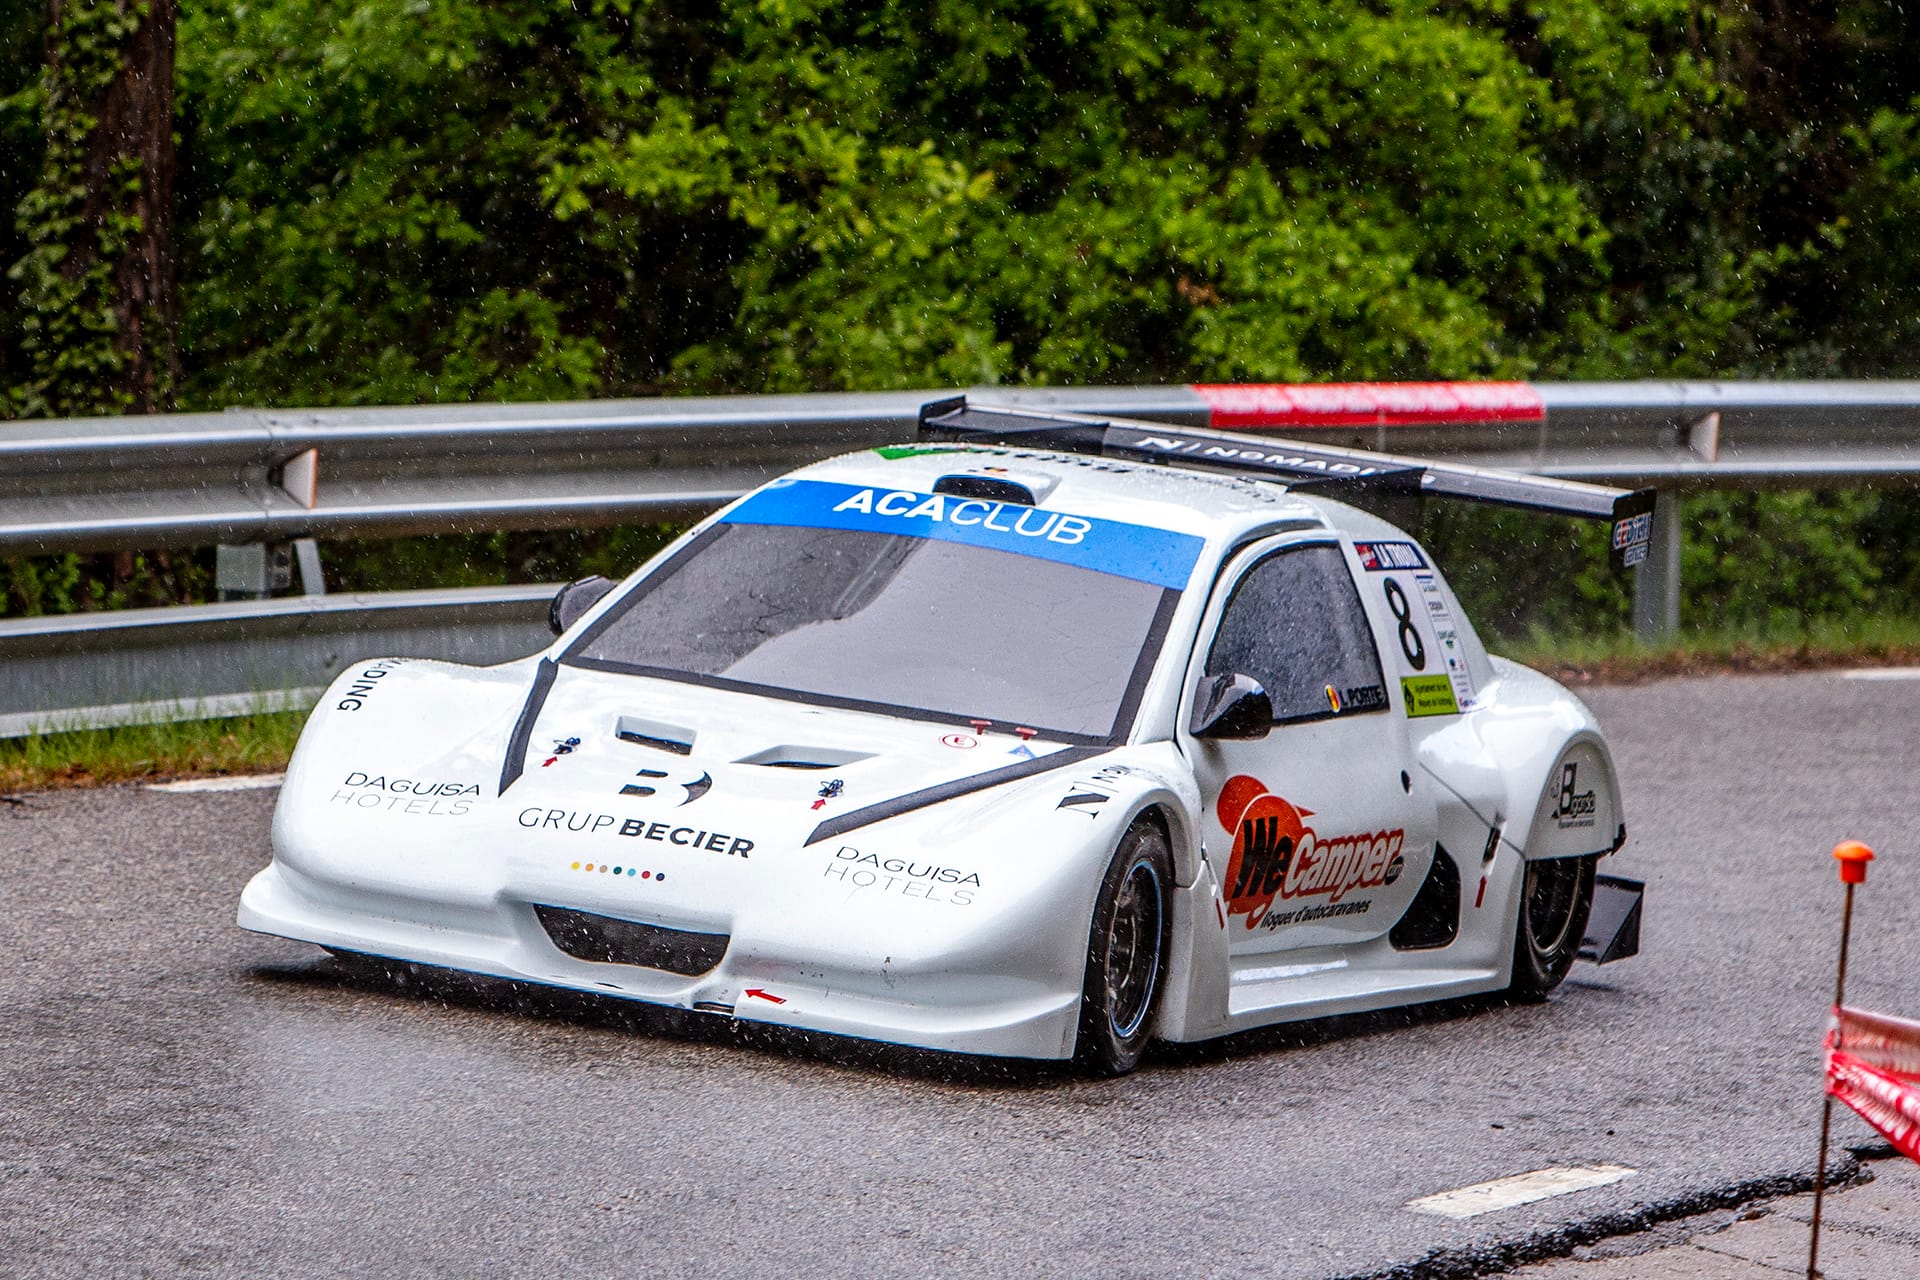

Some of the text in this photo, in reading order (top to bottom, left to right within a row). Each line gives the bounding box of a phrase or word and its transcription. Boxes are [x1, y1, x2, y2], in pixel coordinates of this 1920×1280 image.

[833, 489, 1093, 545] ACACLUB
[1383, 576, 1425, 671] 8
[330, 789, 474, 816] HOTELS
[344, 771, 480, 797] DAGUISA
[518, 806, 755, 859] GRUP BECIER
[824, 861, 976, 906] HOTELS
[835, 845, 982, 888] DAGUISA
[1260, 899, 1372, 931] lloguer d'autocaravanes
